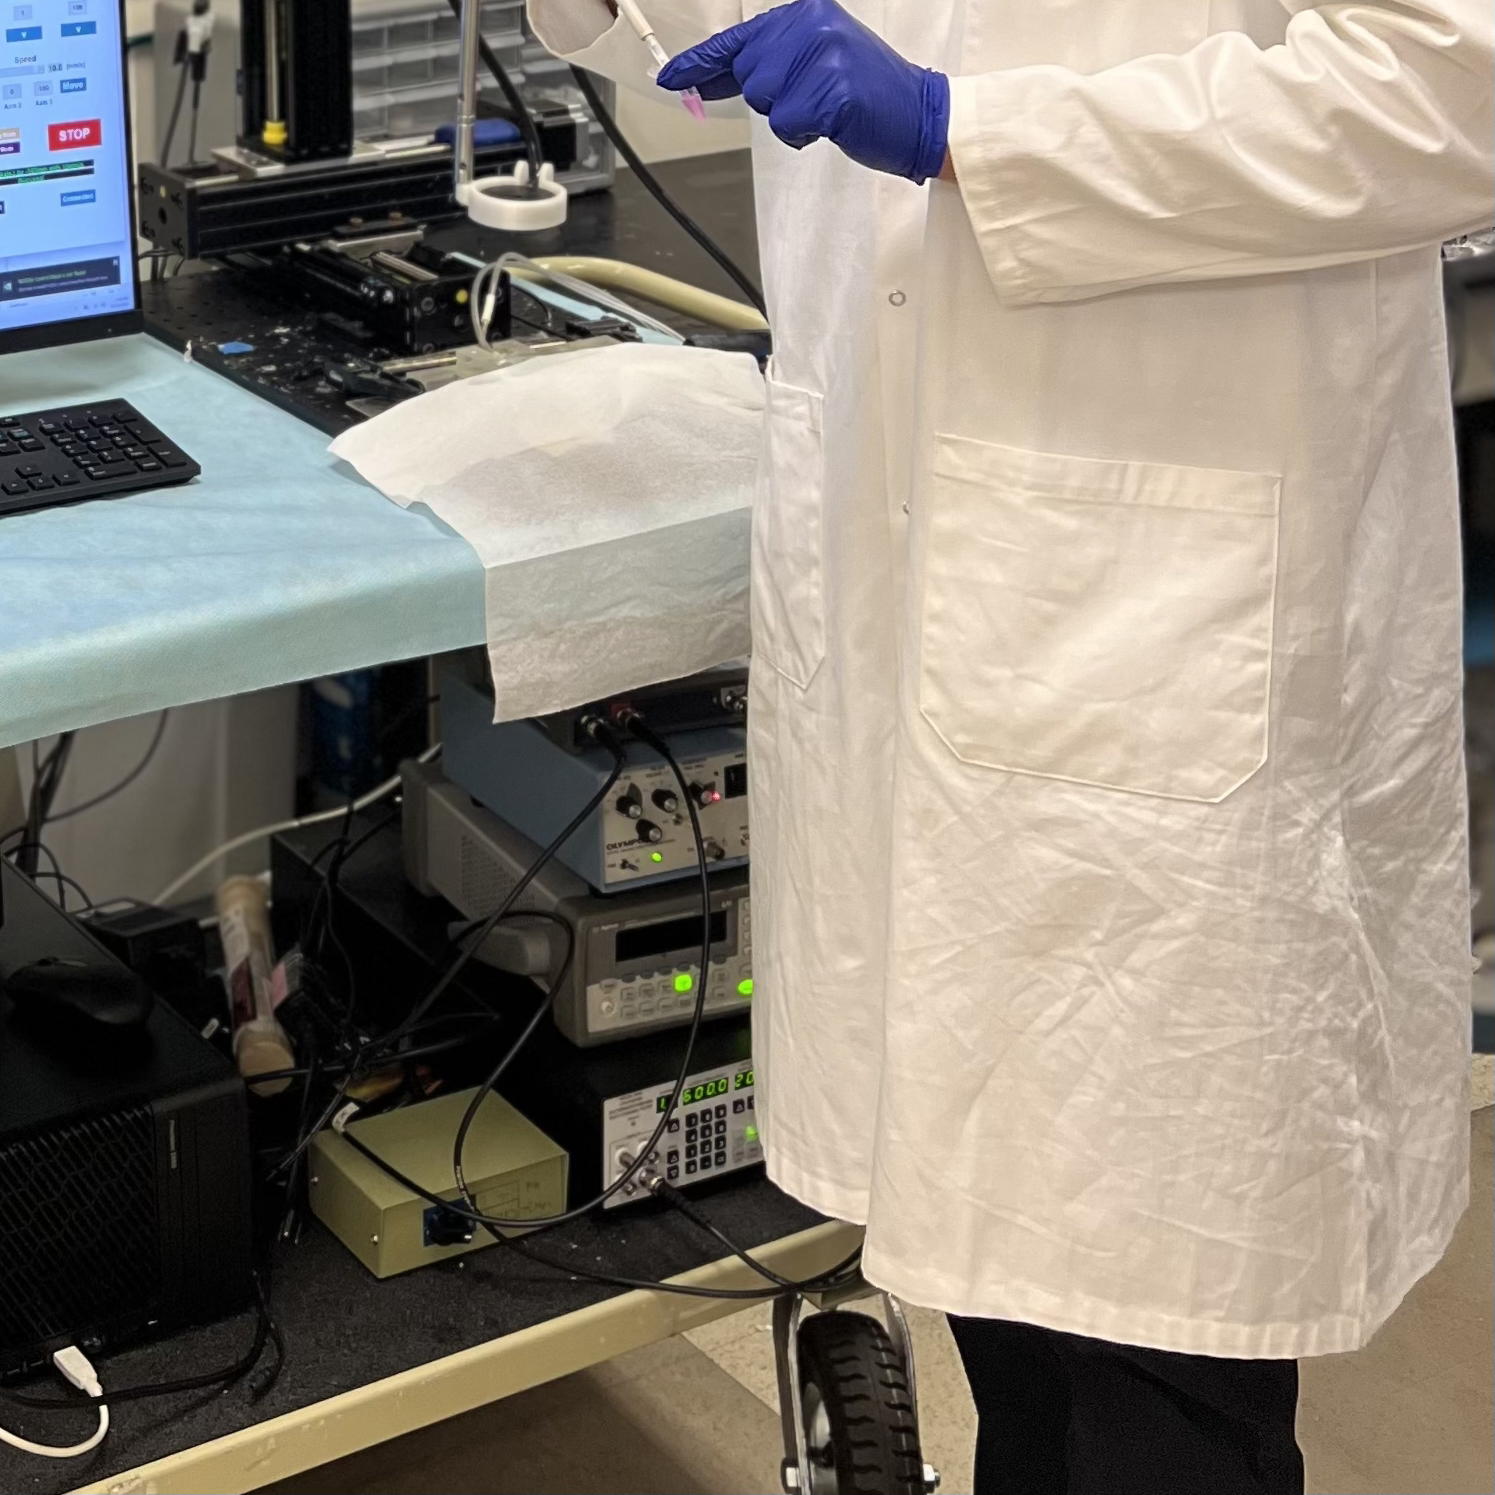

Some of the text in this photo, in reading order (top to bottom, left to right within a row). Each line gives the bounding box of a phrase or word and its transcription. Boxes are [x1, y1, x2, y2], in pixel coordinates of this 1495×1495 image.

[14, 55, 37, 64] Speed
[62, 80, 84, 90] Move
[59, 127, 91, 142] STOP
